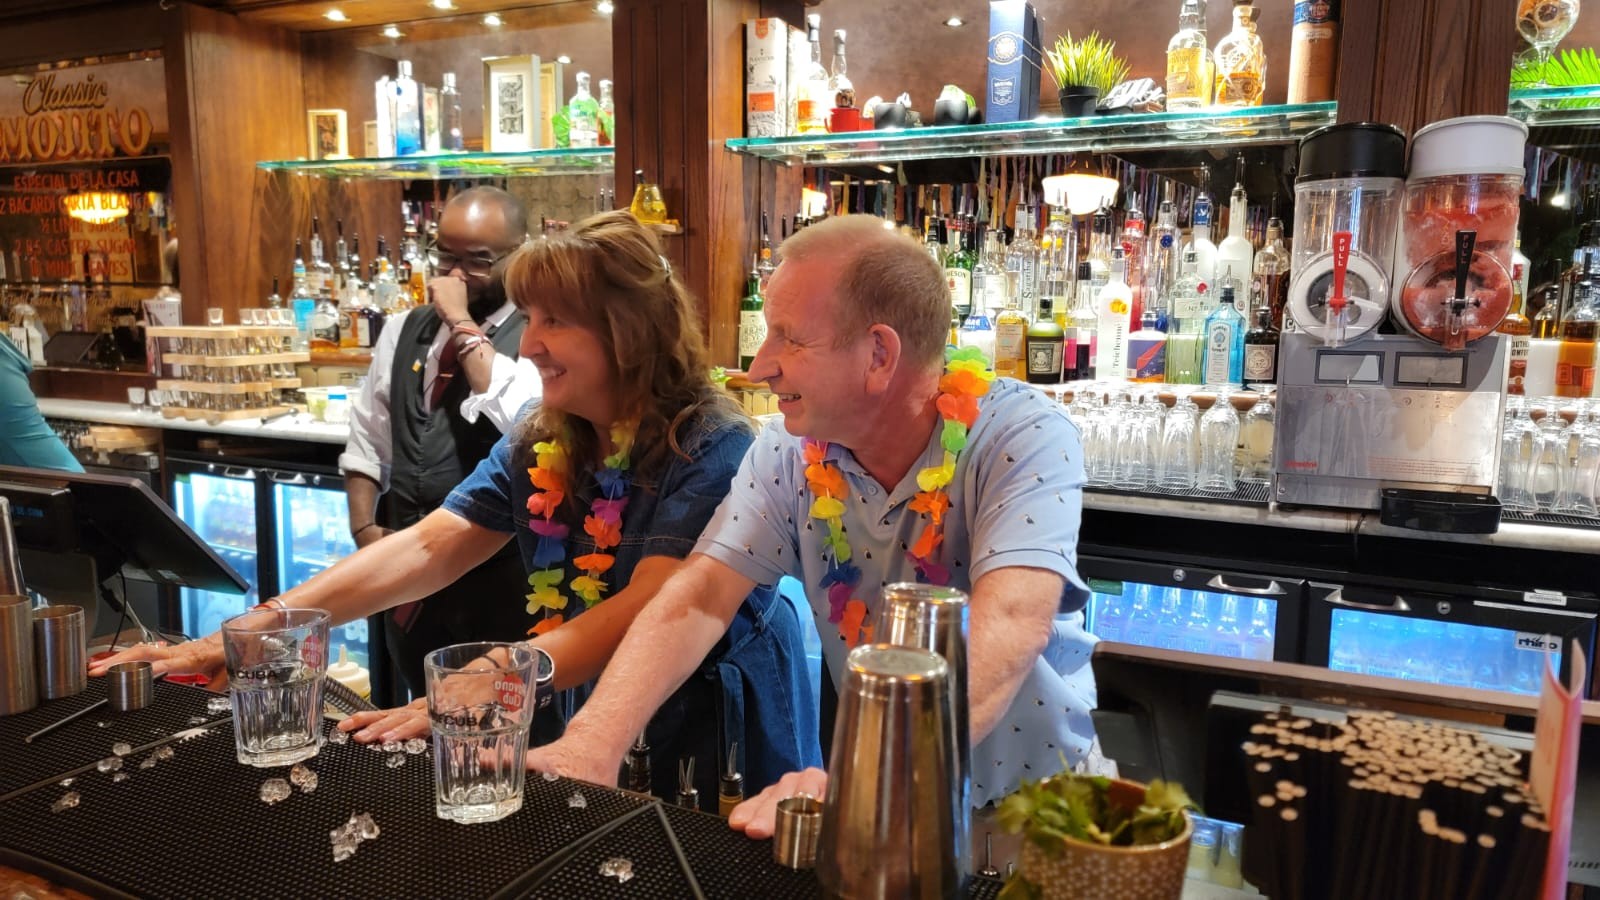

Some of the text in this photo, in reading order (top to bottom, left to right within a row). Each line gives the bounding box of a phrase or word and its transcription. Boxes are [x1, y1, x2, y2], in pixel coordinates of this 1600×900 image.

[23, 74, 108, 115] Classic
[0, 106, 153, 162] MOJITO
[14, 170, 139, 191] ESPECIAL DE LA CASA
[9, 196, 56, 214] BACARDI
[1461, 234, 1469, 264] PULL
[236, 670, 278, 680] CUBA
